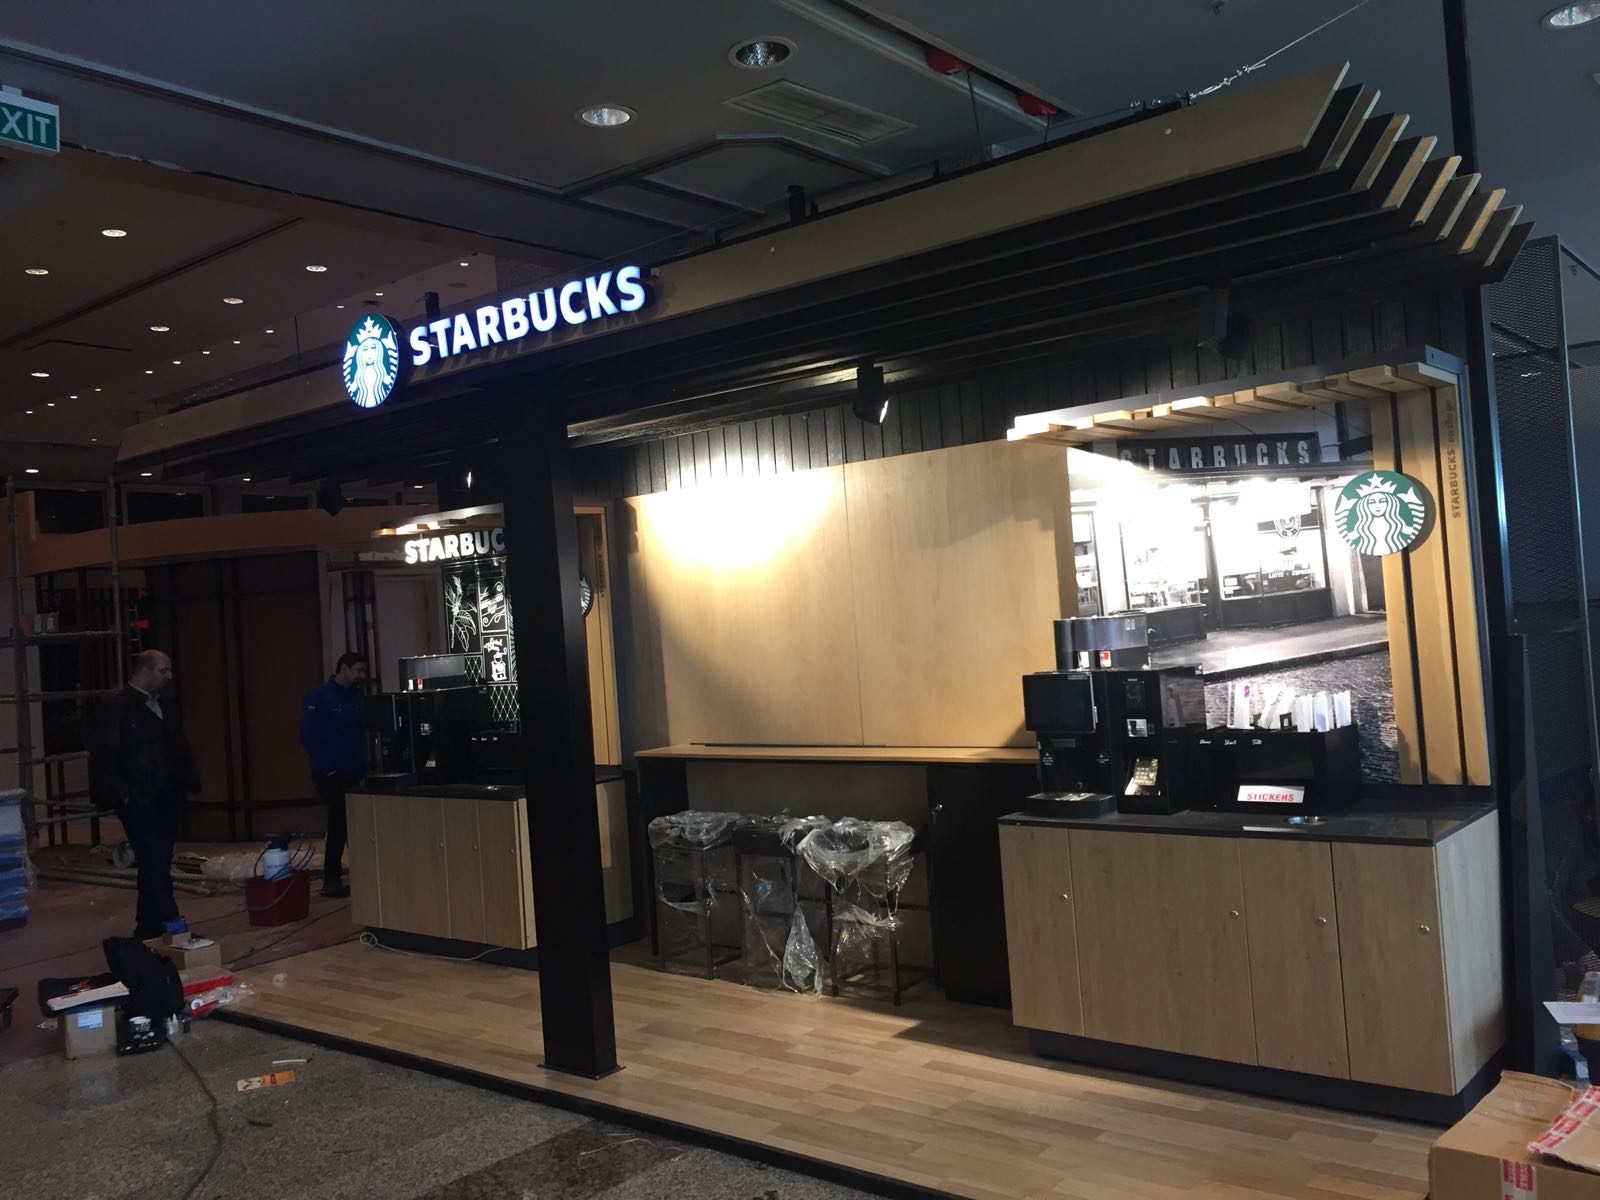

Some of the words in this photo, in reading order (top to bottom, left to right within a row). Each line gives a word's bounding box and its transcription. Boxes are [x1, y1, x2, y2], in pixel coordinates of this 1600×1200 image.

[409, 265, 646, 366] STARBUCKS
[1447, 448, 1461, 519] STARBUCKS
[1247, 792, 1295, 802] STICKERS
